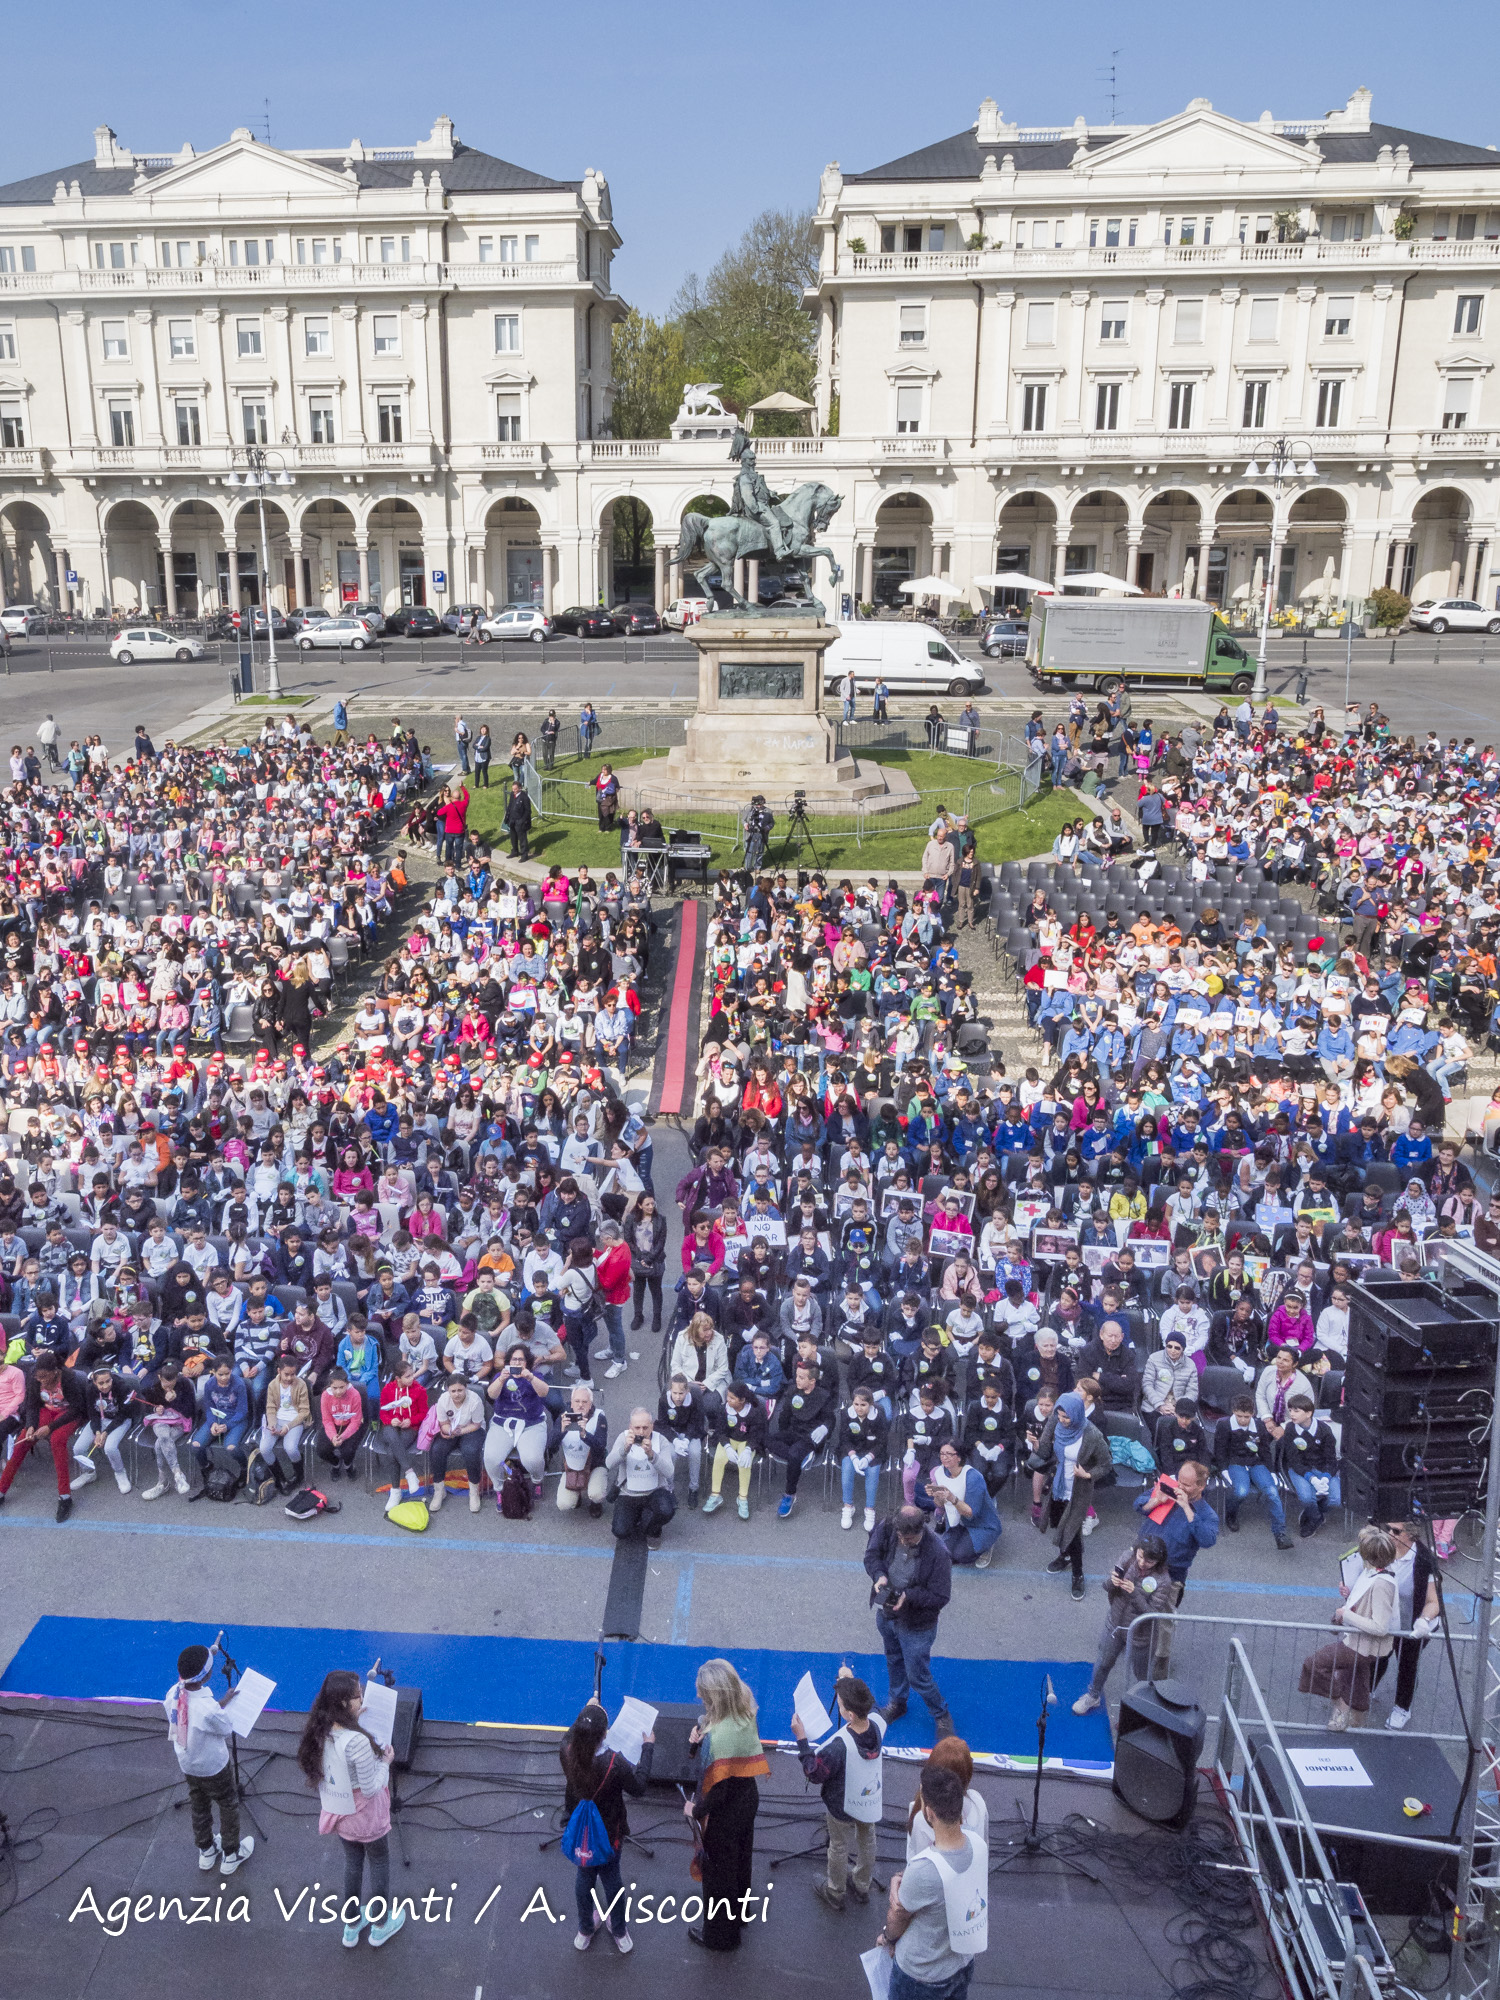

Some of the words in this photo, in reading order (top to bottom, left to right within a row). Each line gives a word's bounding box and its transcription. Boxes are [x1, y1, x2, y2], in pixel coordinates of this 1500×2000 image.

[67, 571, 76, 582] P
[434, 571, 442, 582] P
[754, 1223, 770, 1232] NO
